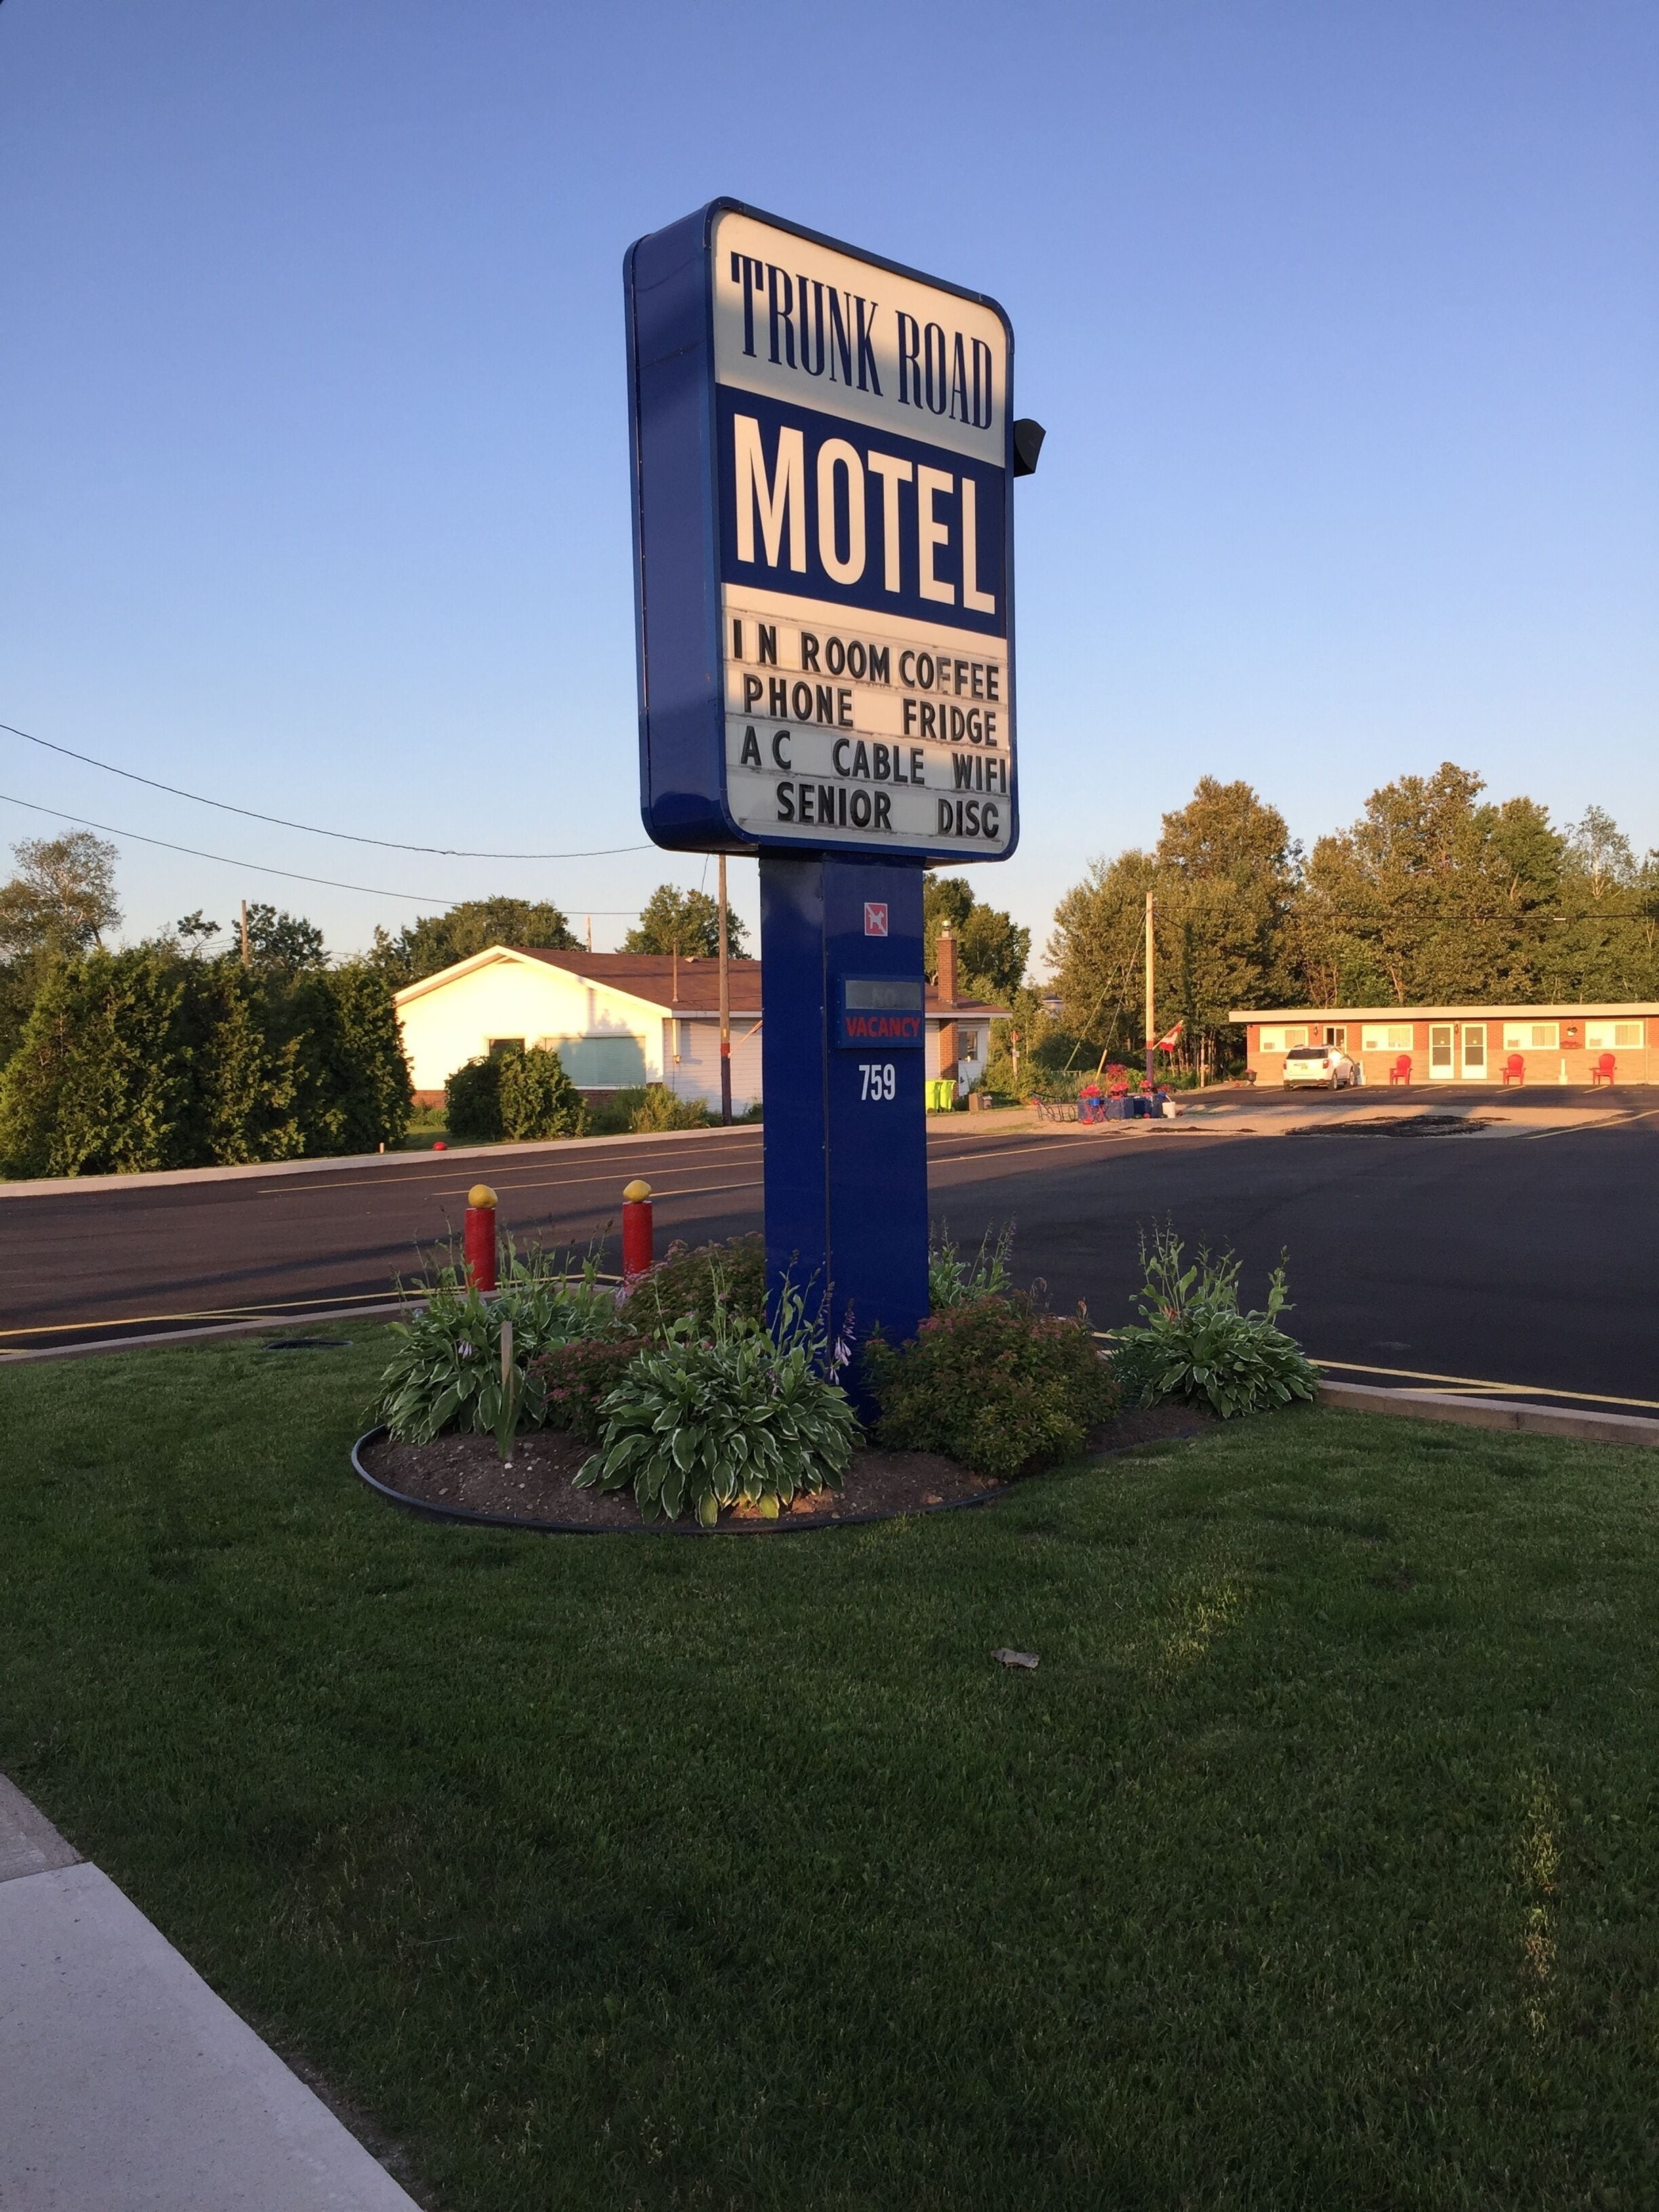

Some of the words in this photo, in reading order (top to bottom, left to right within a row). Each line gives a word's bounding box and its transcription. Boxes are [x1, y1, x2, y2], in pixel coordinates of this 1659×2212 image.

[731, 251, 884, 396] TRUNK
[895, 310, 993, 431] ROAD
[734, 413, 995, 615] MOTEL
[801, 631, 890, 684] ROOM
[899, 650, 1000, 702] COFFEE
[743, 673, 853, 728] PHONE
[903, 698, 997, 747] FRIDGE
[833, 738, 924, 785] CABLE
[952, 752, 1006, 794] WIFI
[777, 782, 892, 830] SENIOR
[938, 798, 1000, 838] DISC
[846, 1017, 921, 1037] VACANCY
[859, 1063, 895, 1101] 759
